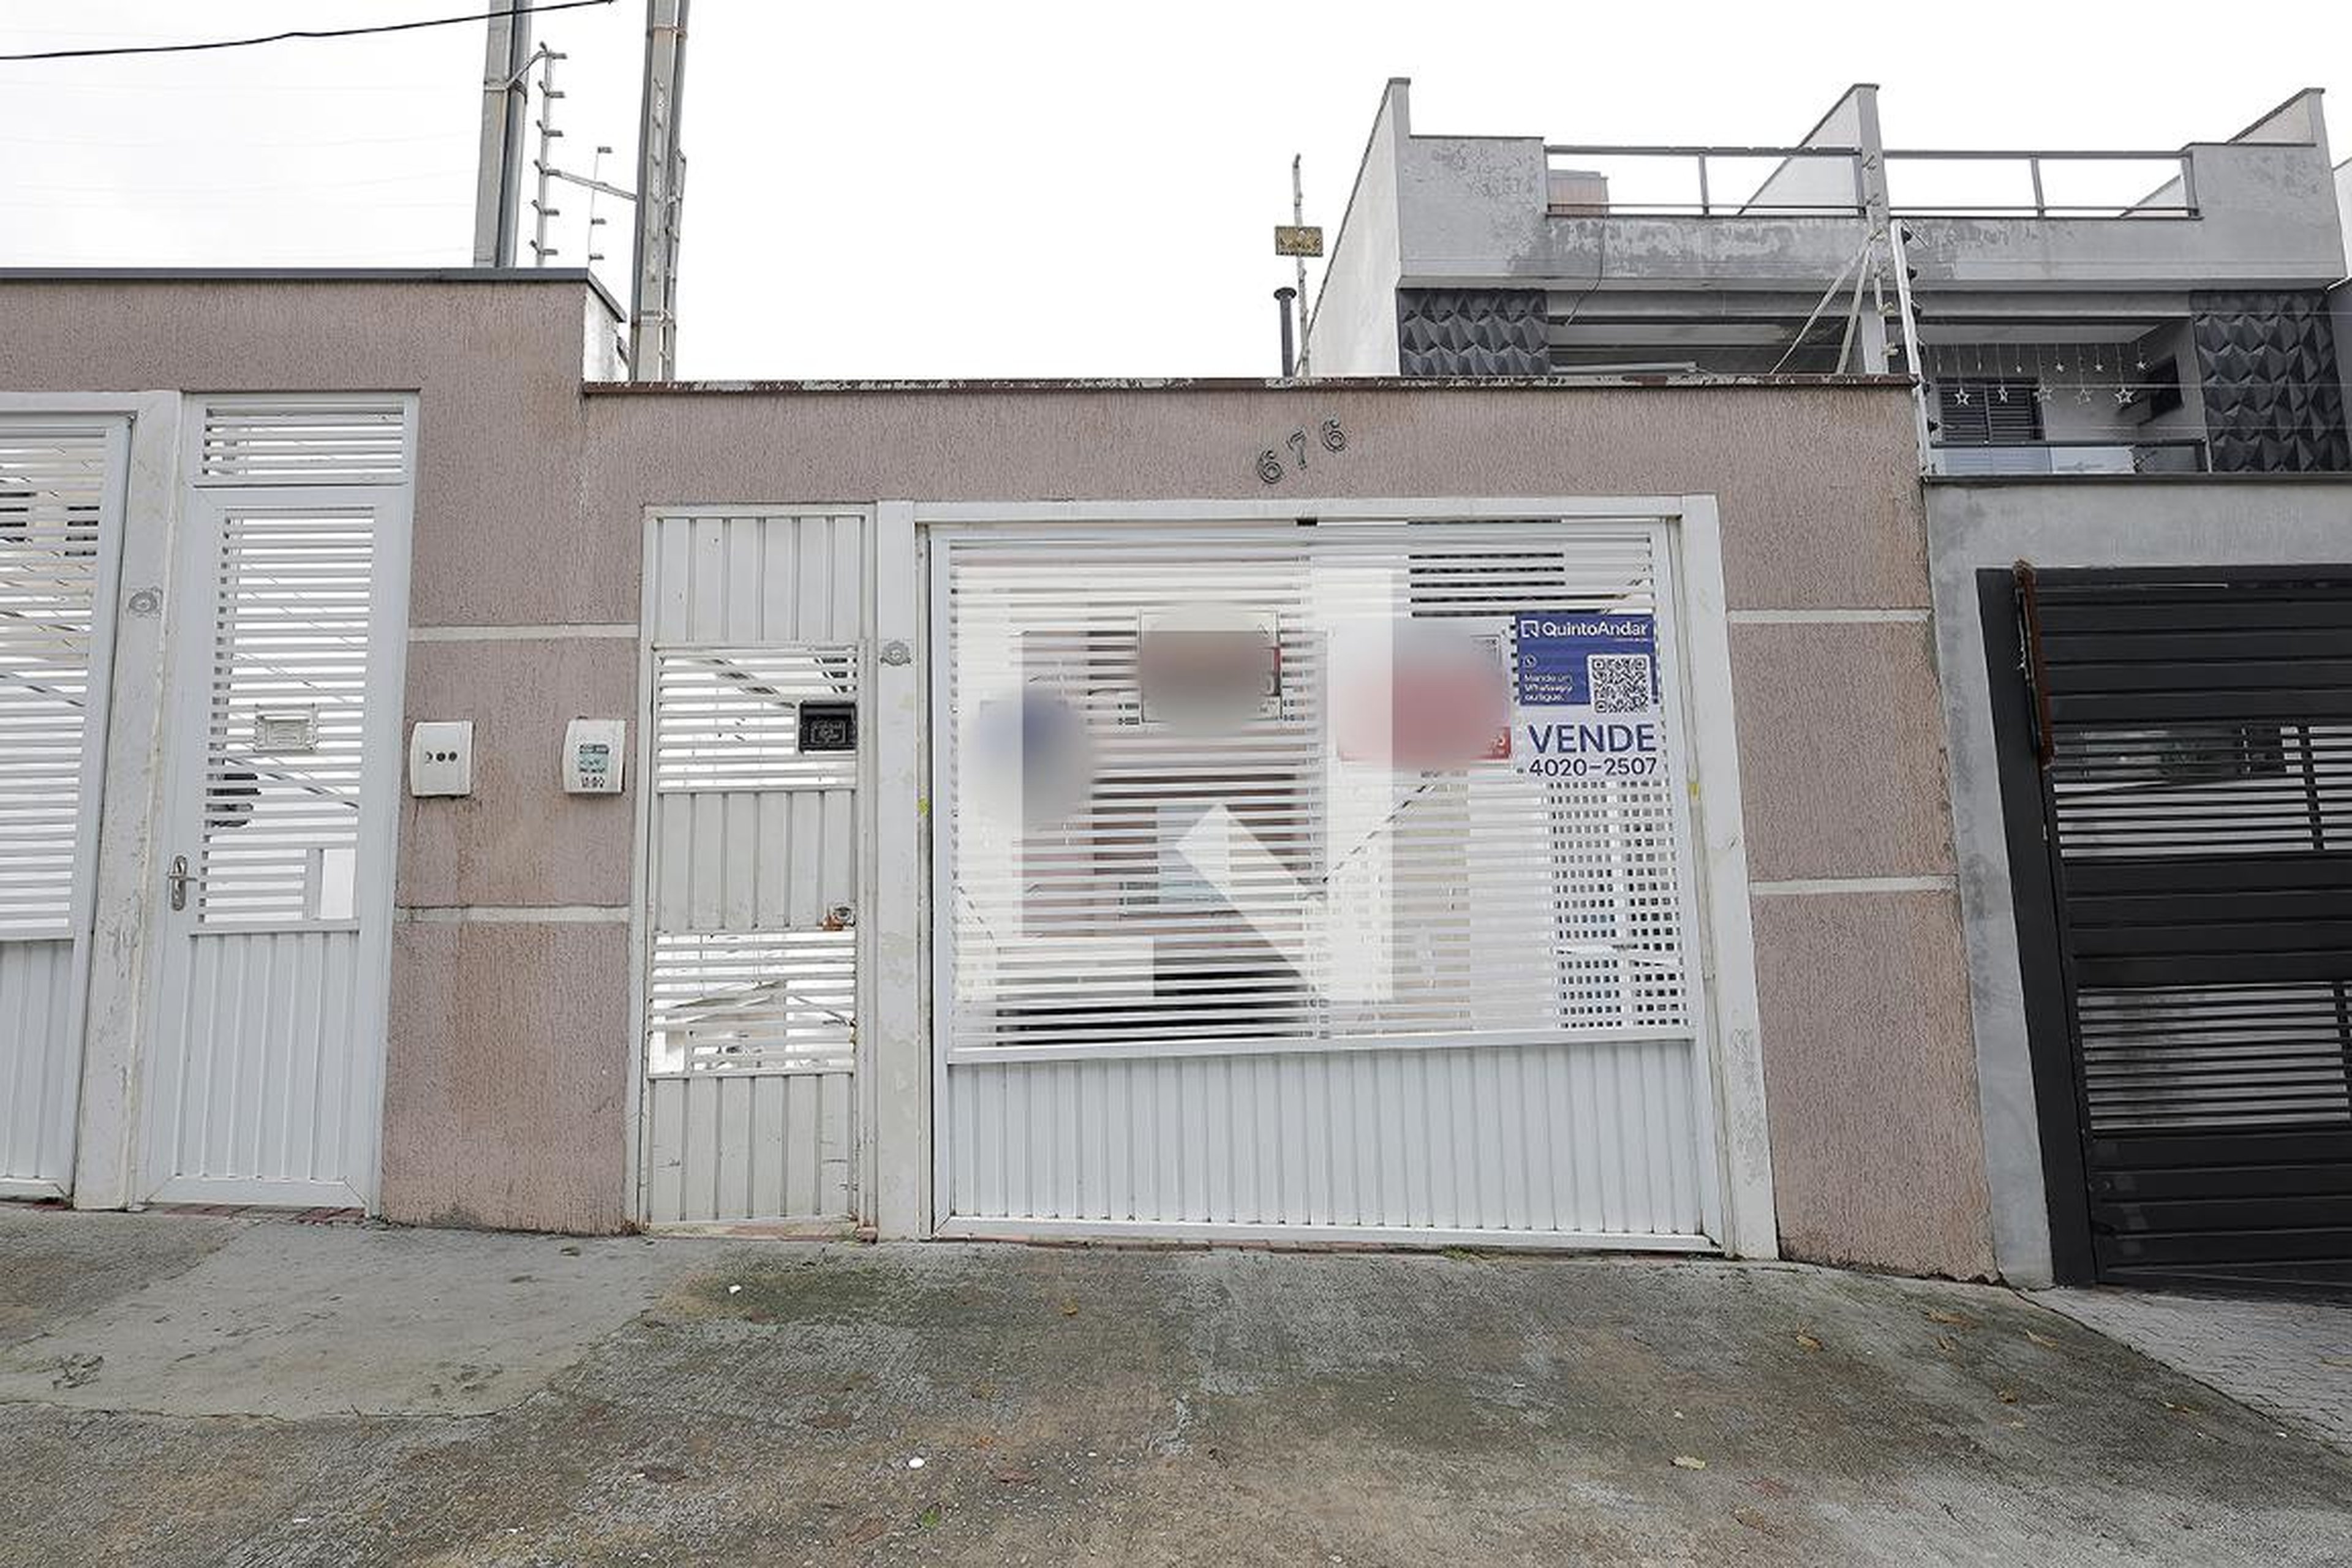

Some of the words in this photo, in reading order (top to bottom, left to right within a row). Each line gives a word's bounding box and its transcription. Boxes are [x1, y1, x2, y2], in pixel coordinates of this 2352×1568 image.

[1256, 419, 1347, 484] 676
[1542, 620, 1648, 636] QuintoAndar
[1528, 724, 1657, 753] VENDE
[1529, 757, 1657, 777] 4020-2507
